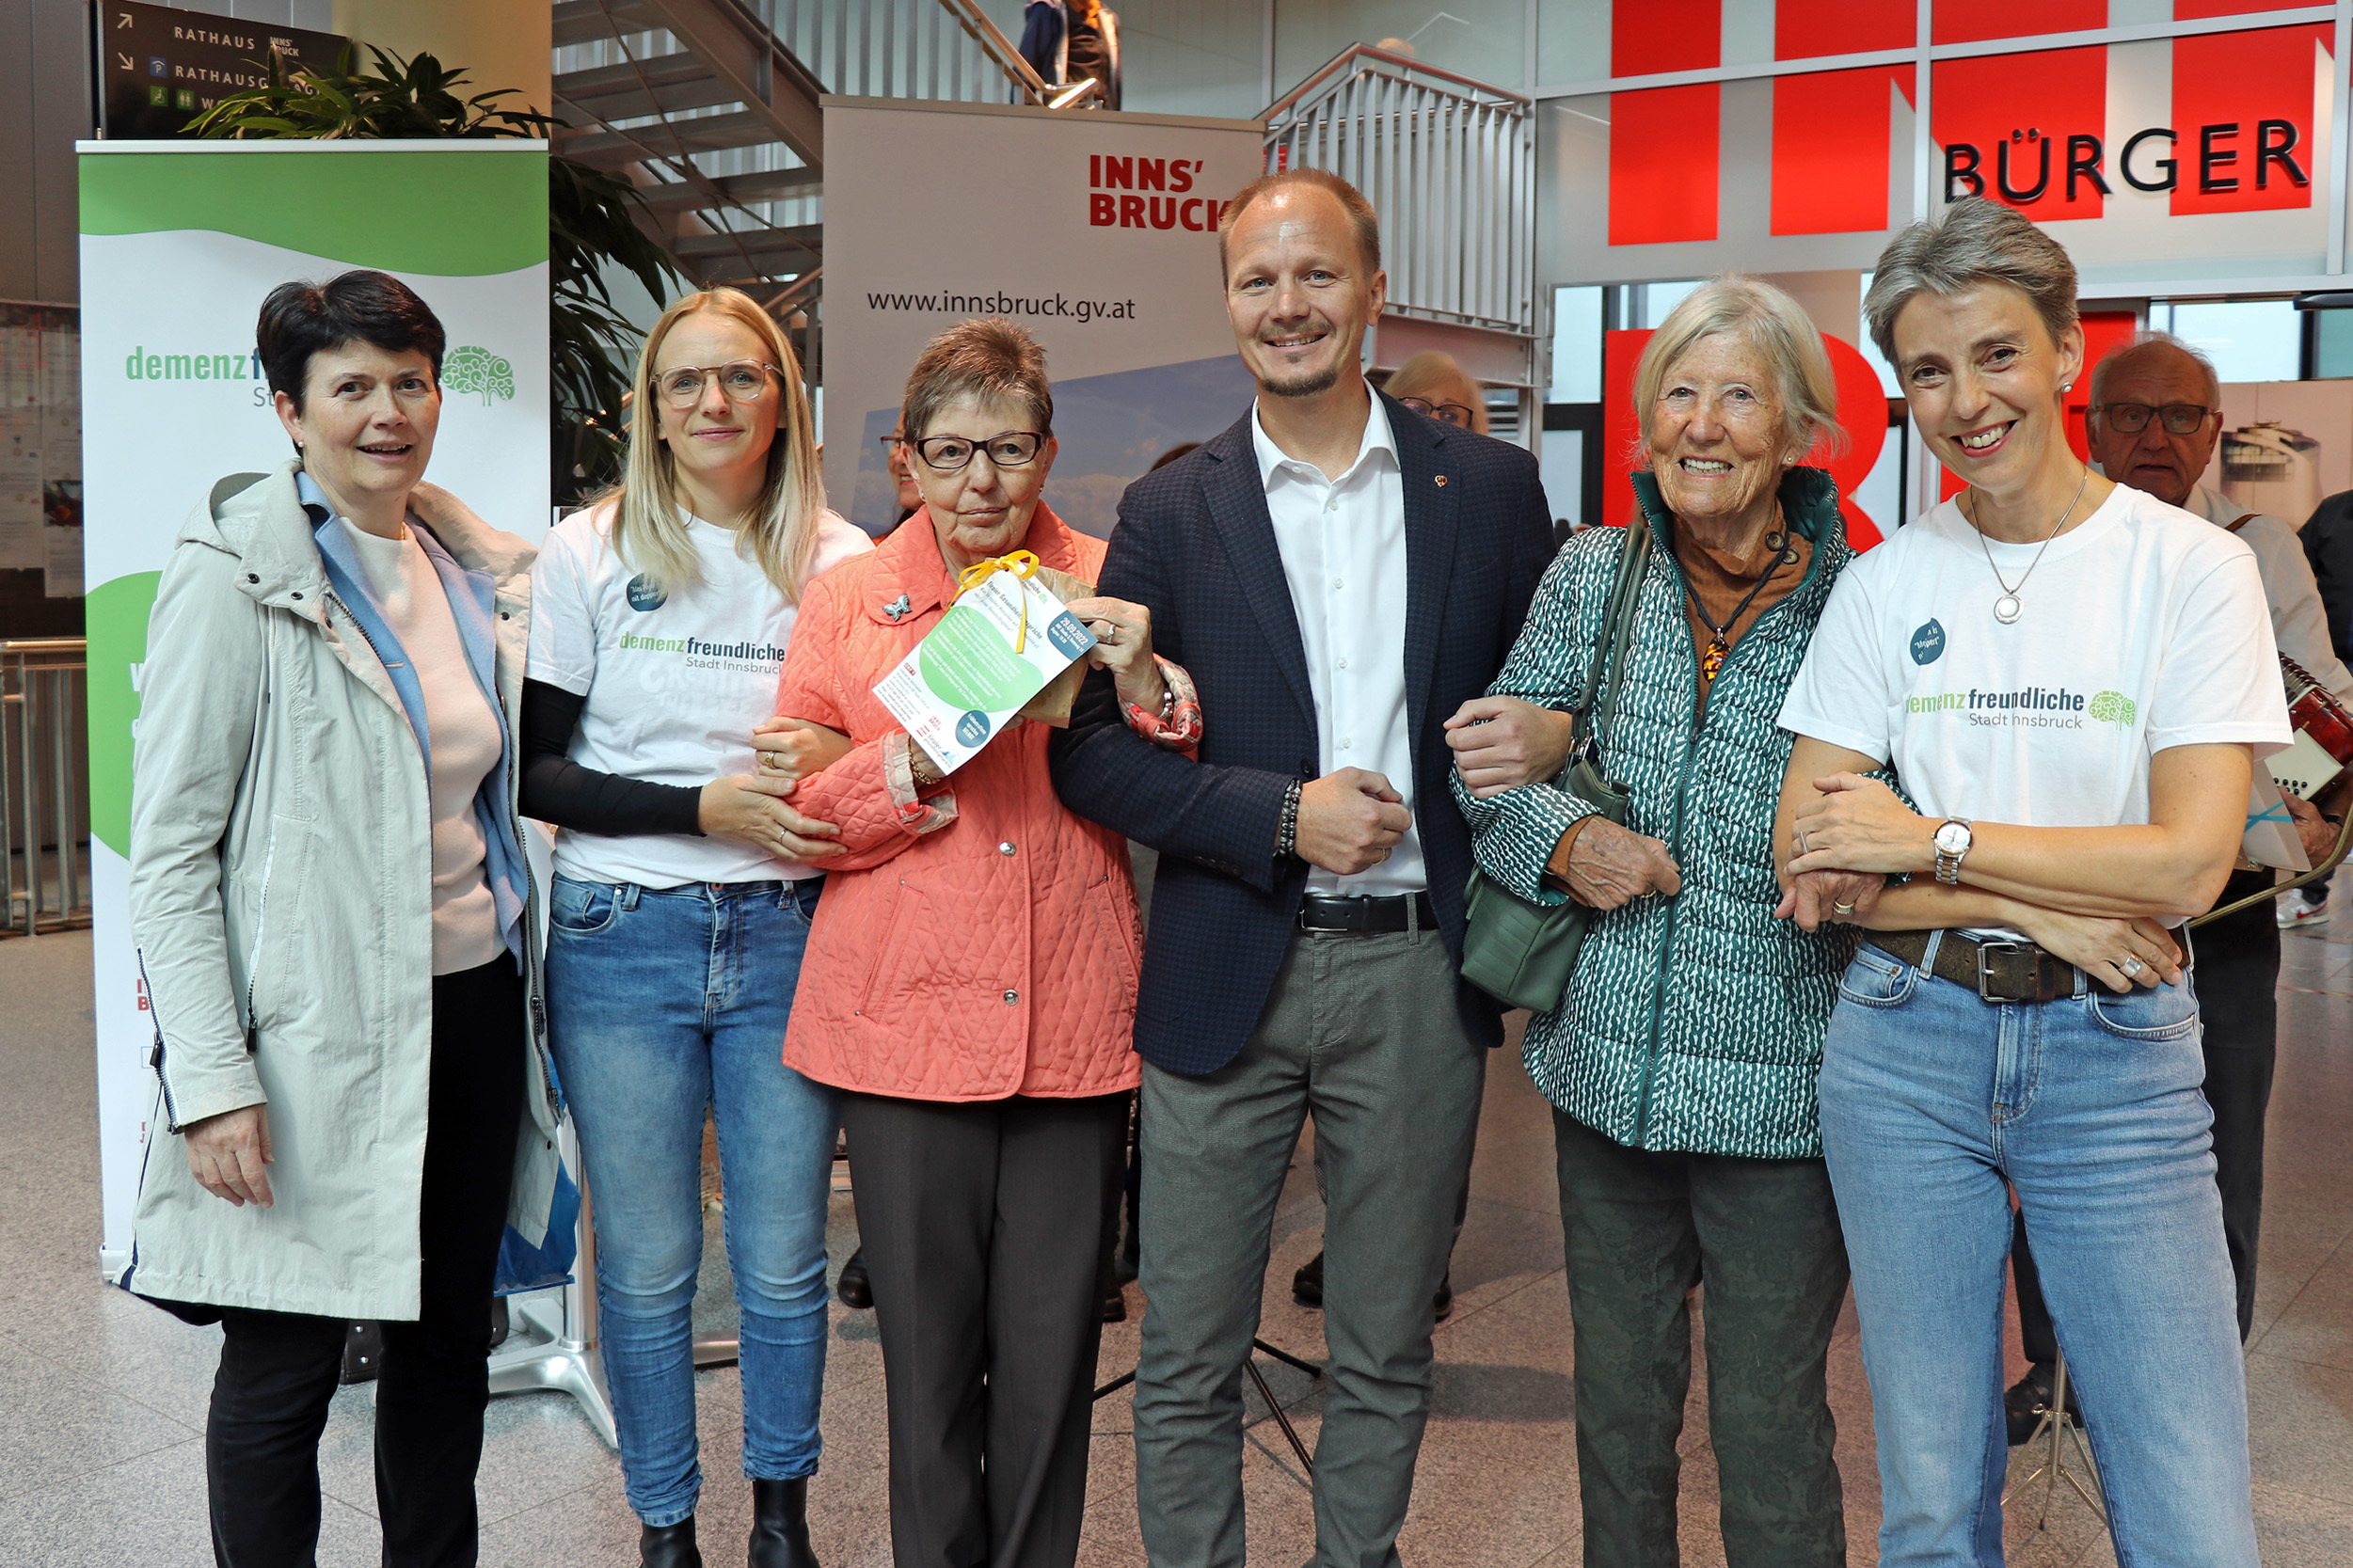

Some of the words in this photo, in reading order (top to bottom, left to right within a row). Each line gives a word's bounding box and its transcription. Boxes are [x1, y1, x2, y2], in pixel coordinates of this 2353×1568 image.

[174, 26, 255, 50] RATHAUS
[1089, 154, 1203, 192] INNS'
[1944, 119, 2309, 204] BÜRGER
[866, 291, 1136, 324] www.innsbruck.gv.at
[986, 580, 1001, 595] Tiroler
[1059, 615, 1089, 645] 29.09.2022
[686, 657, 720, 670] Stadt
[1969, 712, 2008, 726] Stadt
